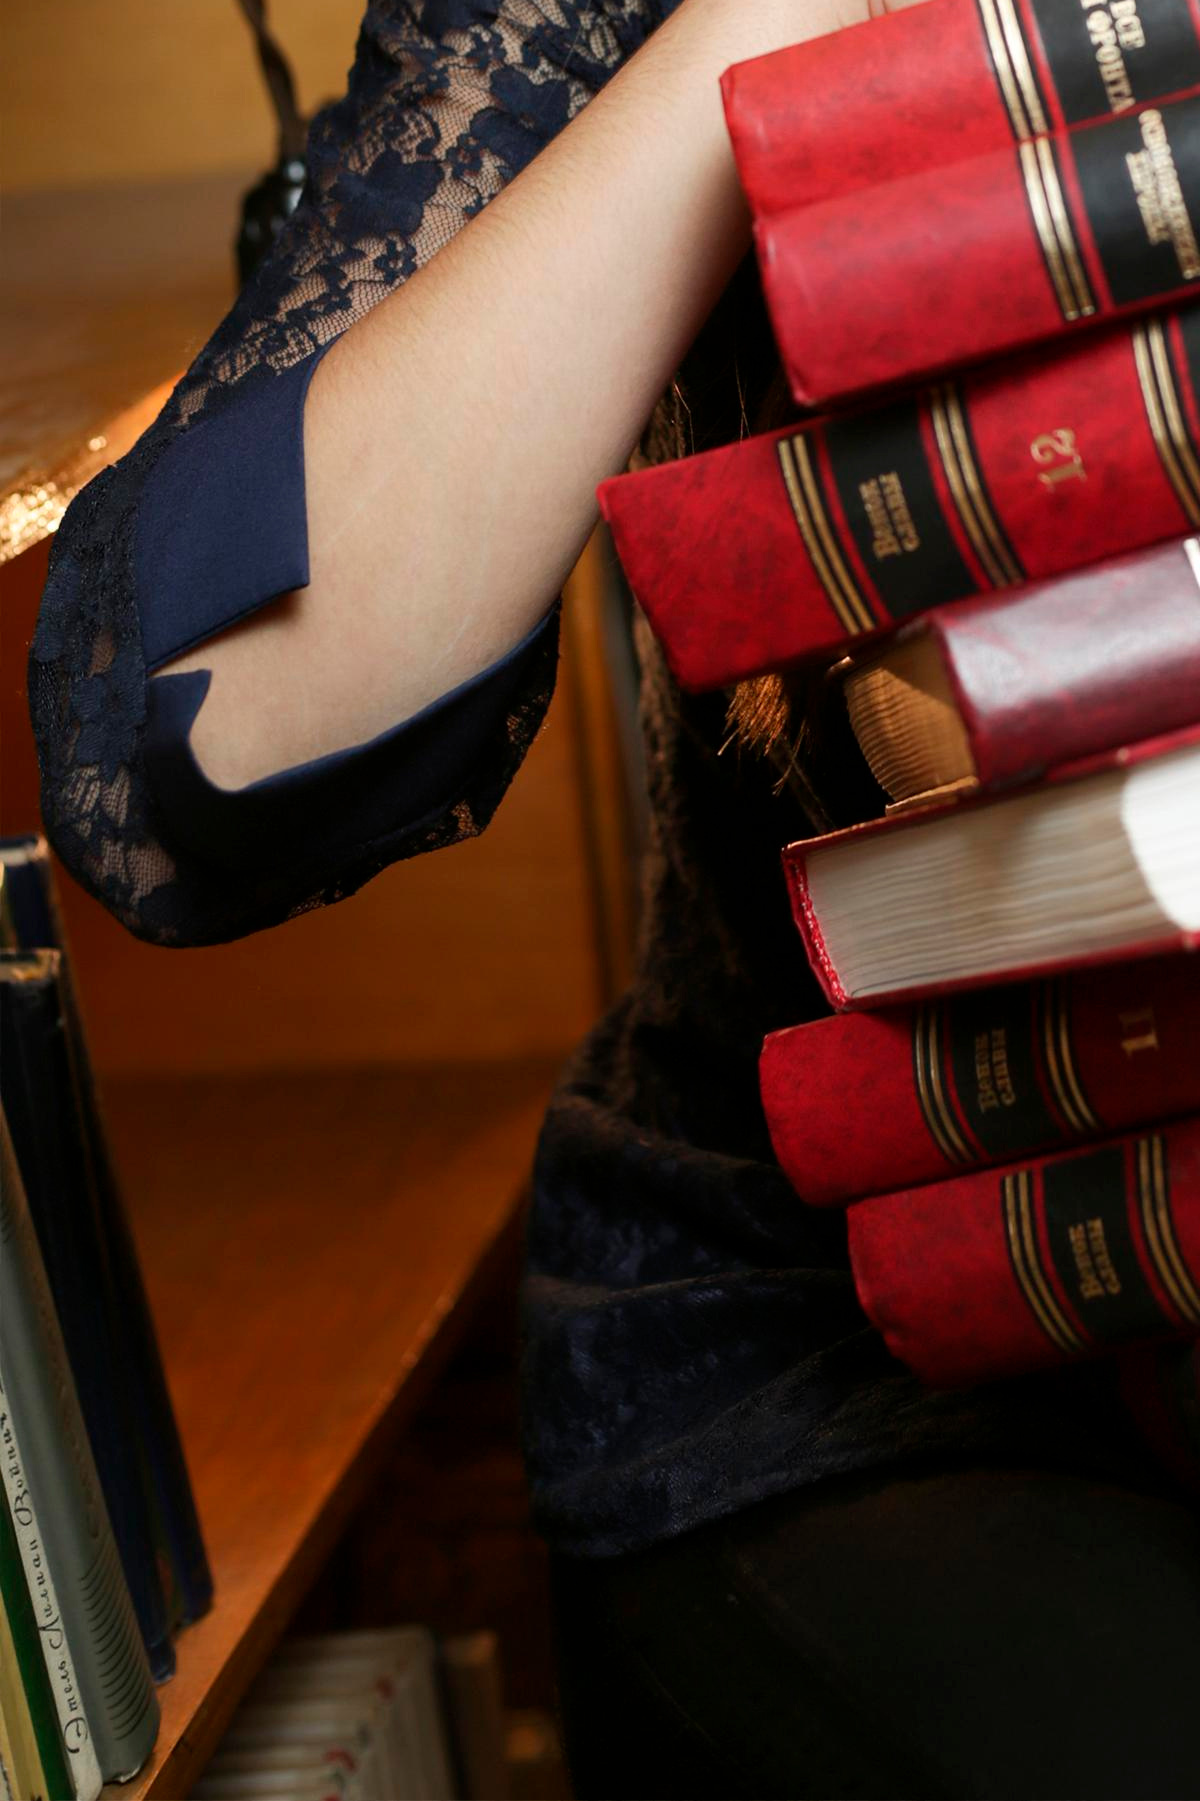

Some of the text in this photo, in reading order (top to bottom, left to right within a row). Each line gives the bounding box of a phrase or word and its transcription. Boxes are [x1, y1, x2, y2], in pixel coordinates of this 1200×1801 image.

[1086, 9, 1134, 114] ФРОНТА
[1030, 428, 1087, 493] 12
[859, 478, 900, 558] Венок
[879, 471, 919, 551] славы
[991, 1029, 1016, 1106] славы
[1118, 1007, 1159, 1057] 11
[974, 1033, 999, 1113] Венок
[1067, 1221, 1104, 1299] Венок
[1085, 1216, 1121, 1296] славы
[30, 1539, 63, 1649] Лилиан
[58, 1661, 88, 1753] Этель
